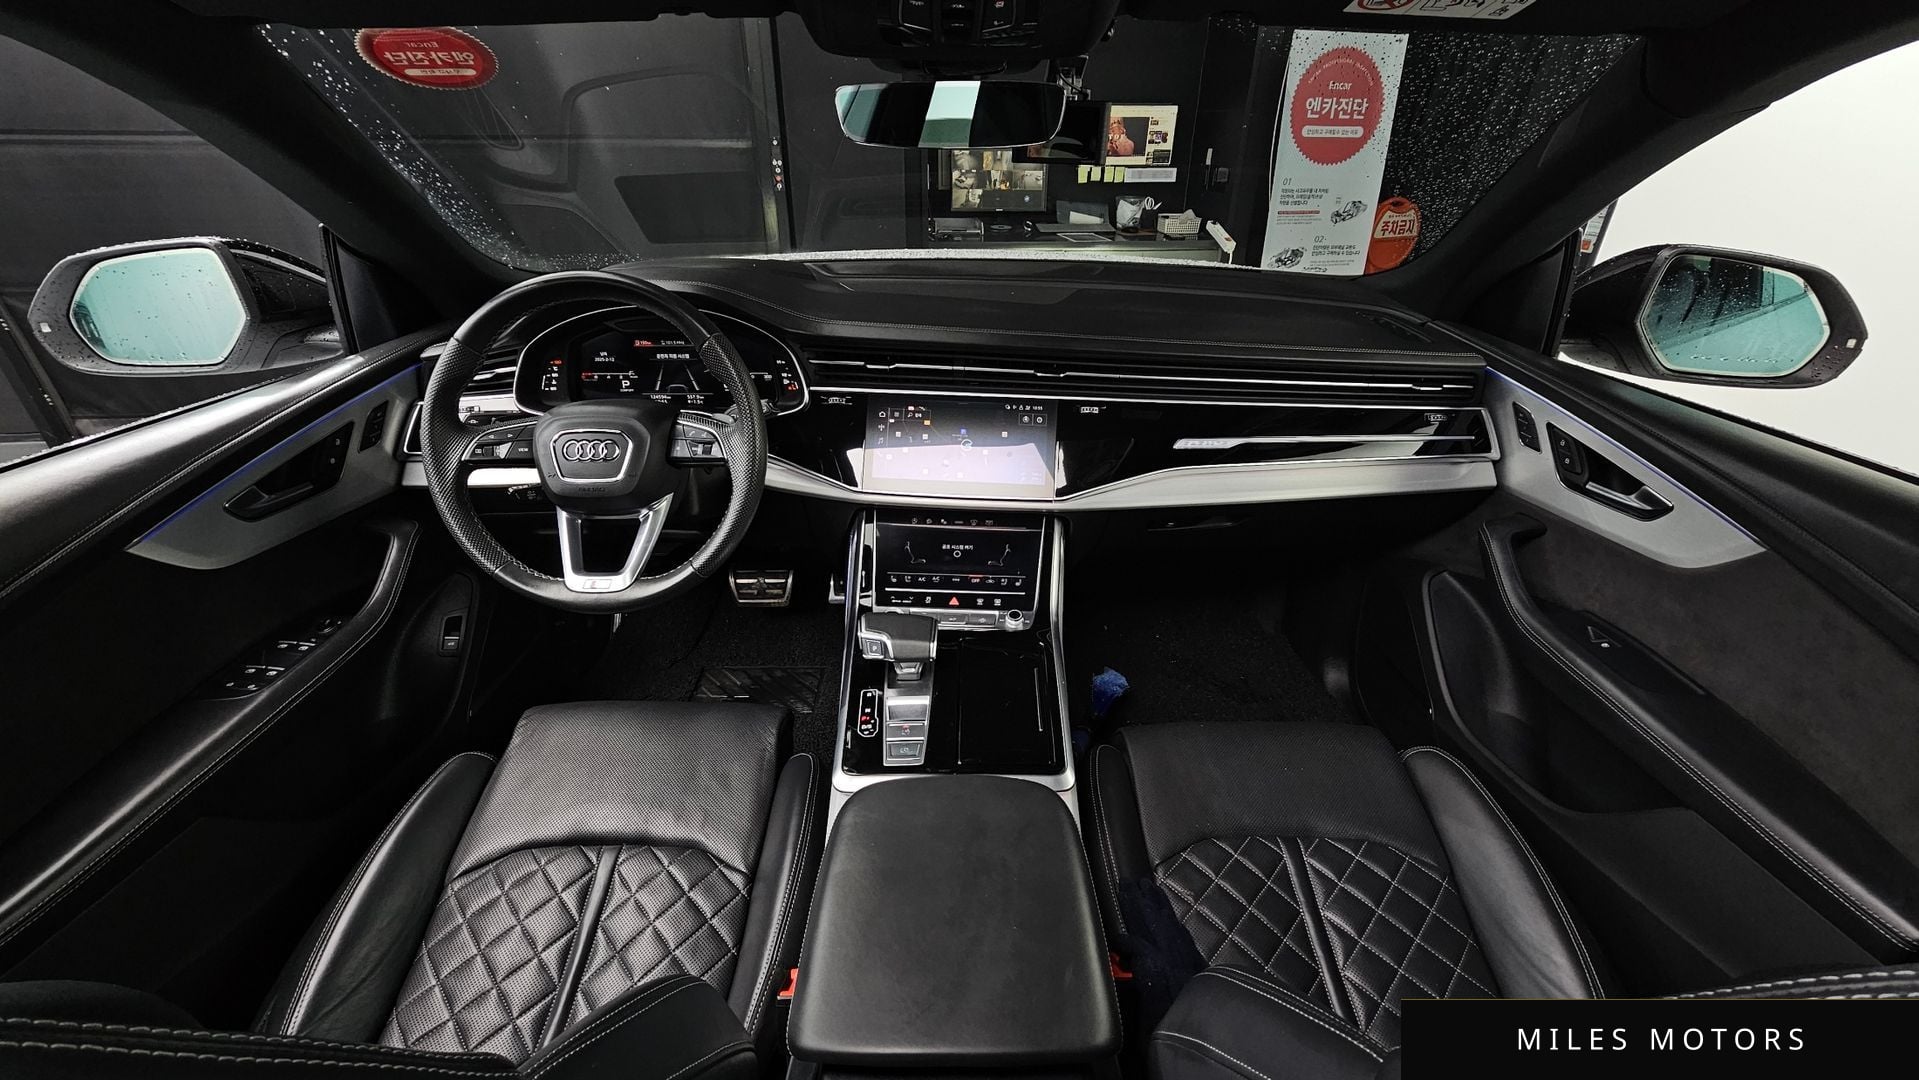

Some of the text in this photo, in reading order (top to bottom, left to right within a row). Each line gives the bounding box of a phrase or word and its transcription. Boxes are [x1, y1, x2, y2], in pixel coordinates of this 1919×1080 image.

[1329, 80, 1352, 90] Encar
[1305, 97, 1369, 119] 엔카진단
[1283, 178, 1292, 186] 01
[1381, 219, 1416, 236] 주차금지
[621, 380, 631, 389] P
